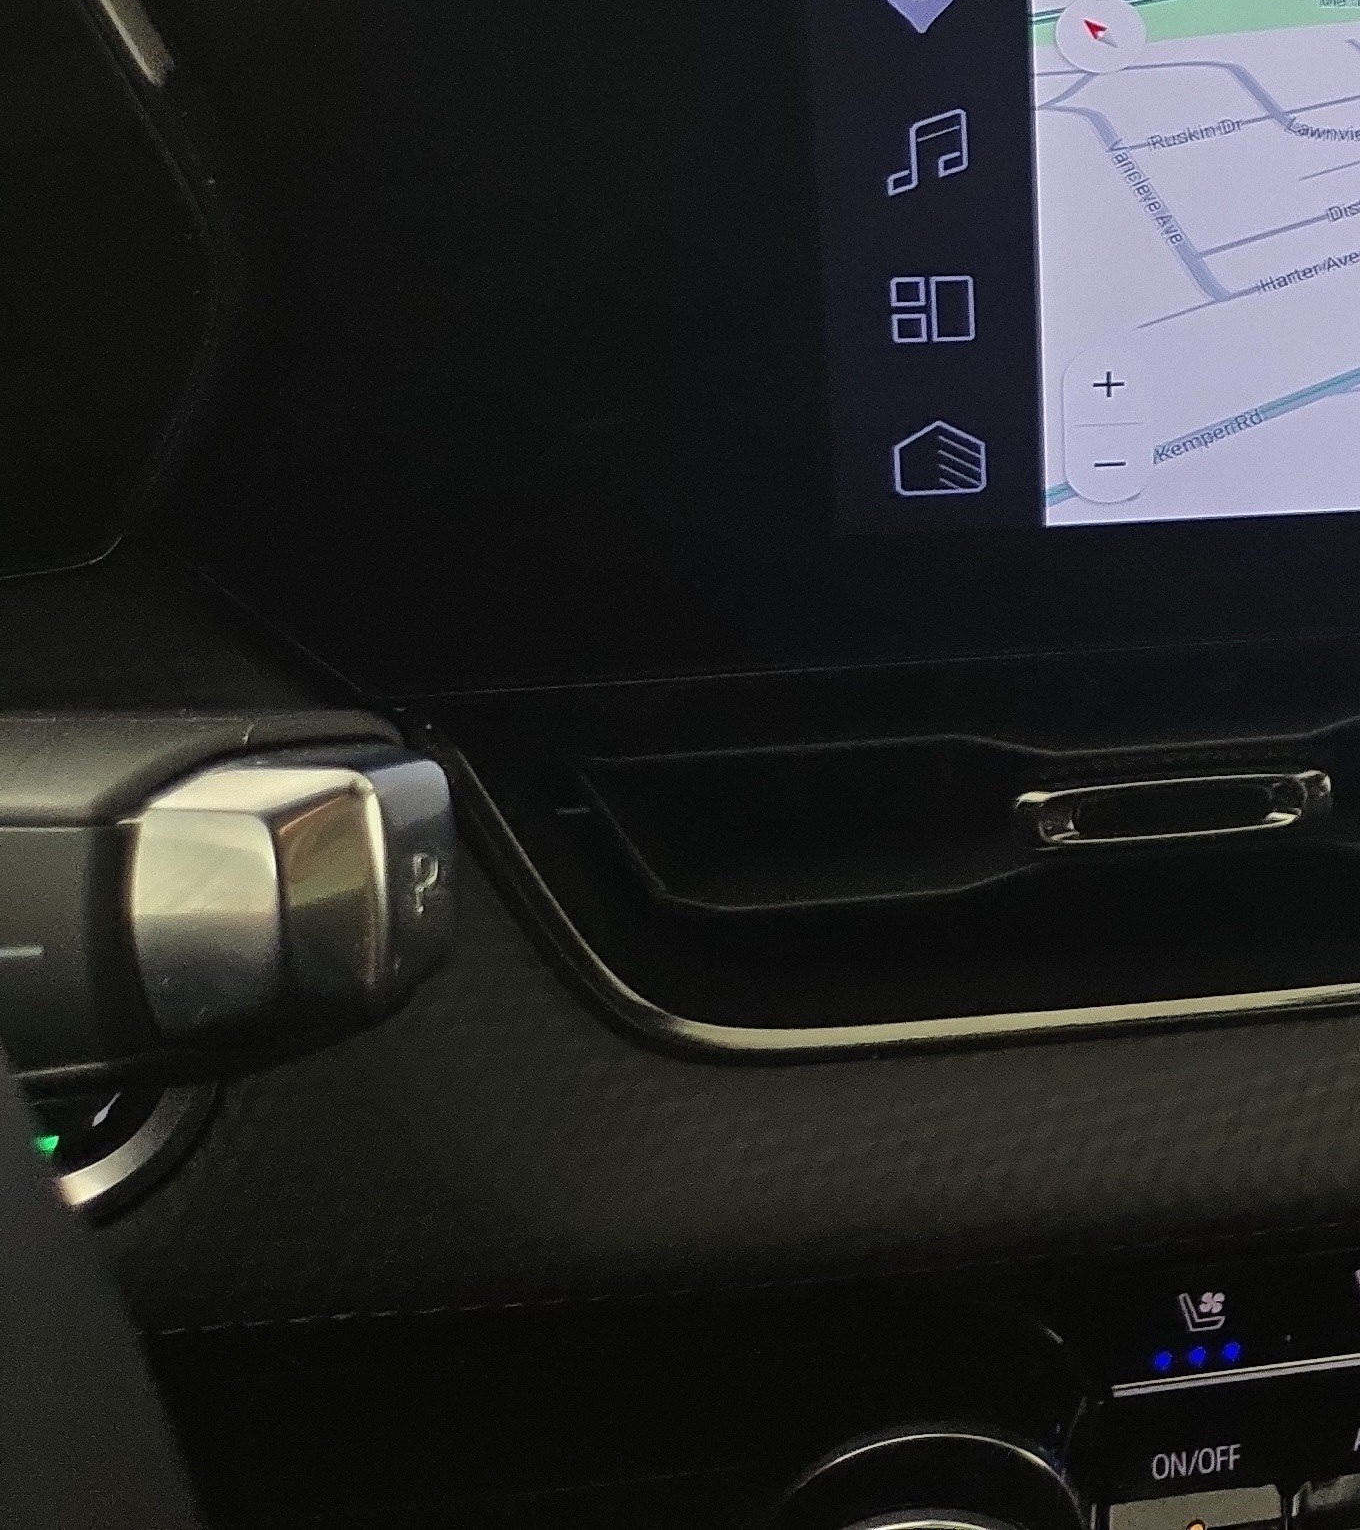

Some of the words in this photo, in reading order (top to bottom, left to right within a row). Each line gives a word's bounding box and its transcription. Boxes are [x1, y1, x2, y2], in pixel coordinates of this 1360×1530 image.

[1147, 124, 1217, 151] Ruskin
[1219, 117, 1244, 136] Dr
[1155, 208, 1185, 247] Ave
[1234, 409, 1264, 431] Rd
[411, 854, 439, 912] P
[1150, 1443, 1242, 1482] ON/OFF
